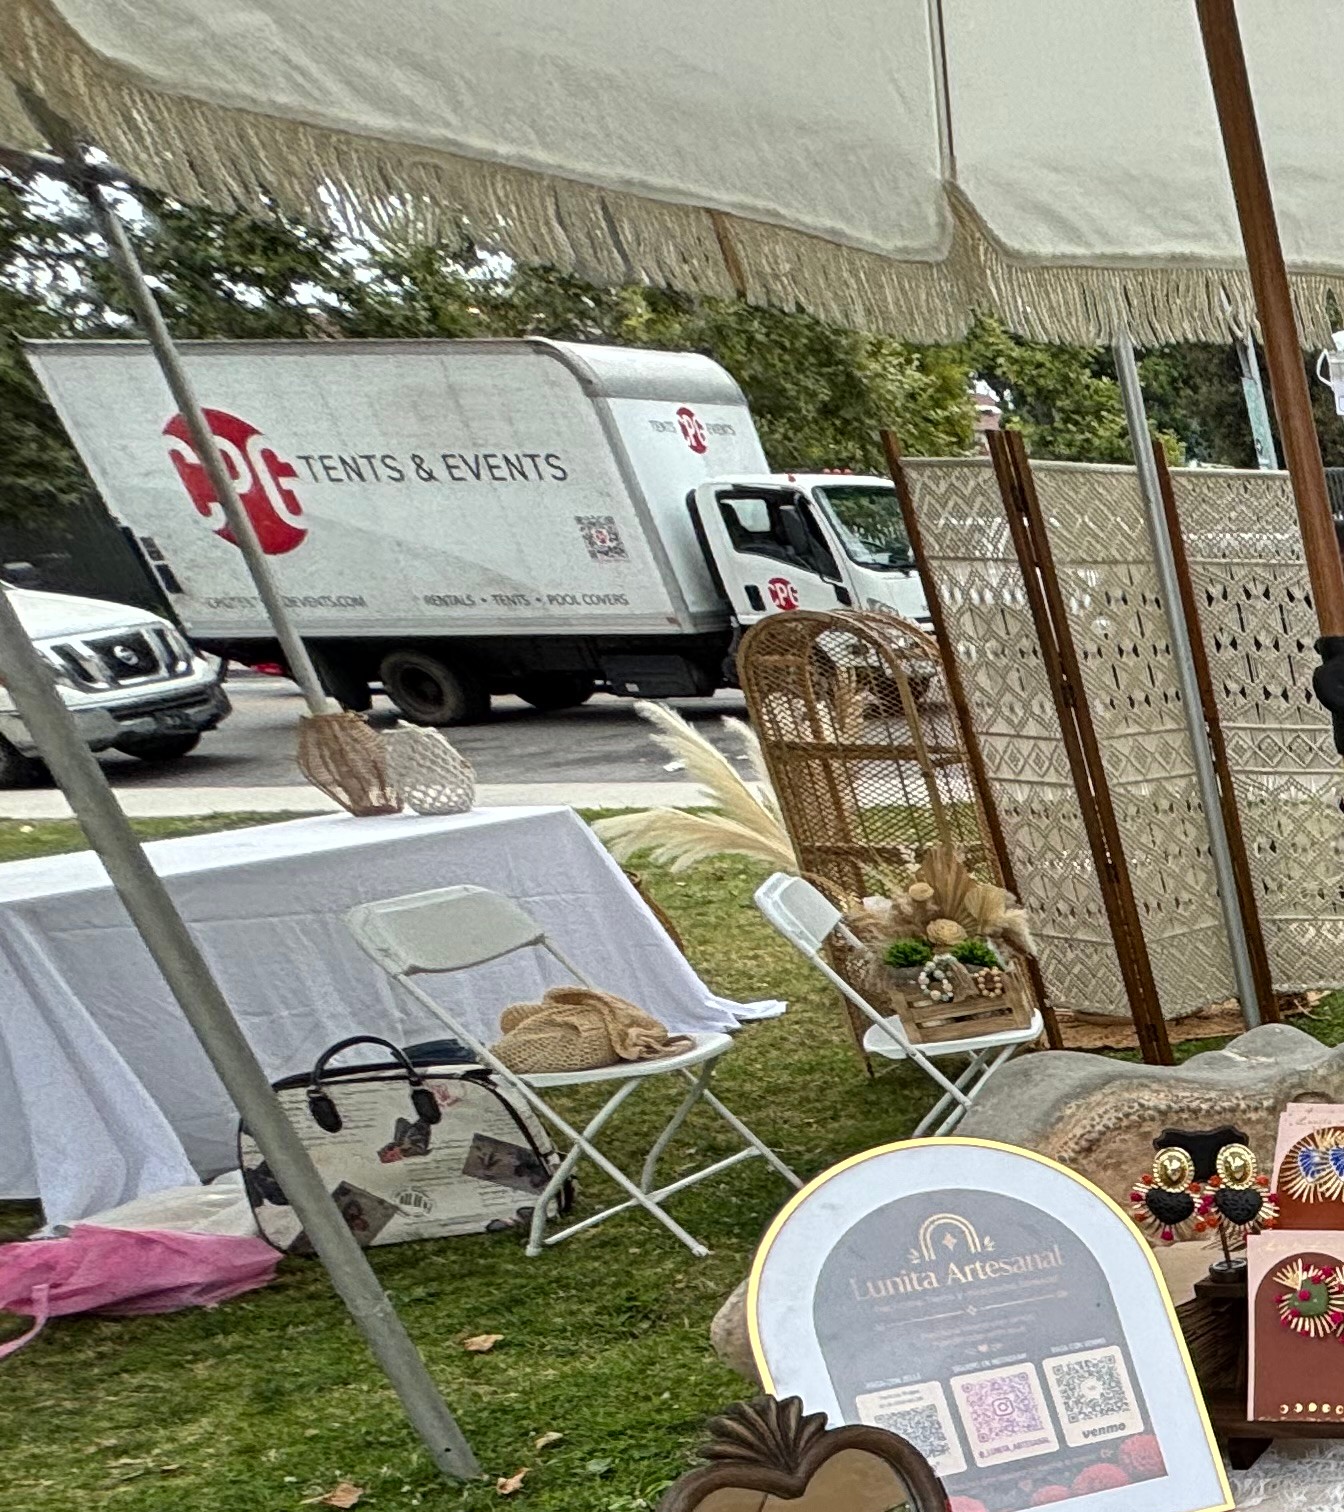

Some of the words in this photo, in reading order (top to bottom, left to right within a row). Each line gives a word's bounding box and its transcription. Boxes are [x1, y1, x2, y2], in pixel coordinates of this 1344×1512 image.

[297, 454, 405, 483] TENTS
[411, 453, 440, 482] &
[442, 453, 568, 482] EVENTS
[491, 594, 531, 606] TENTS
[547, 593, 580, 605] POOL
[850, 1270, 940, 1301] Lunita
[948, 1244, 1065, 1285] Artesanal
[1083, 1422, 1127, 1439] venmo
